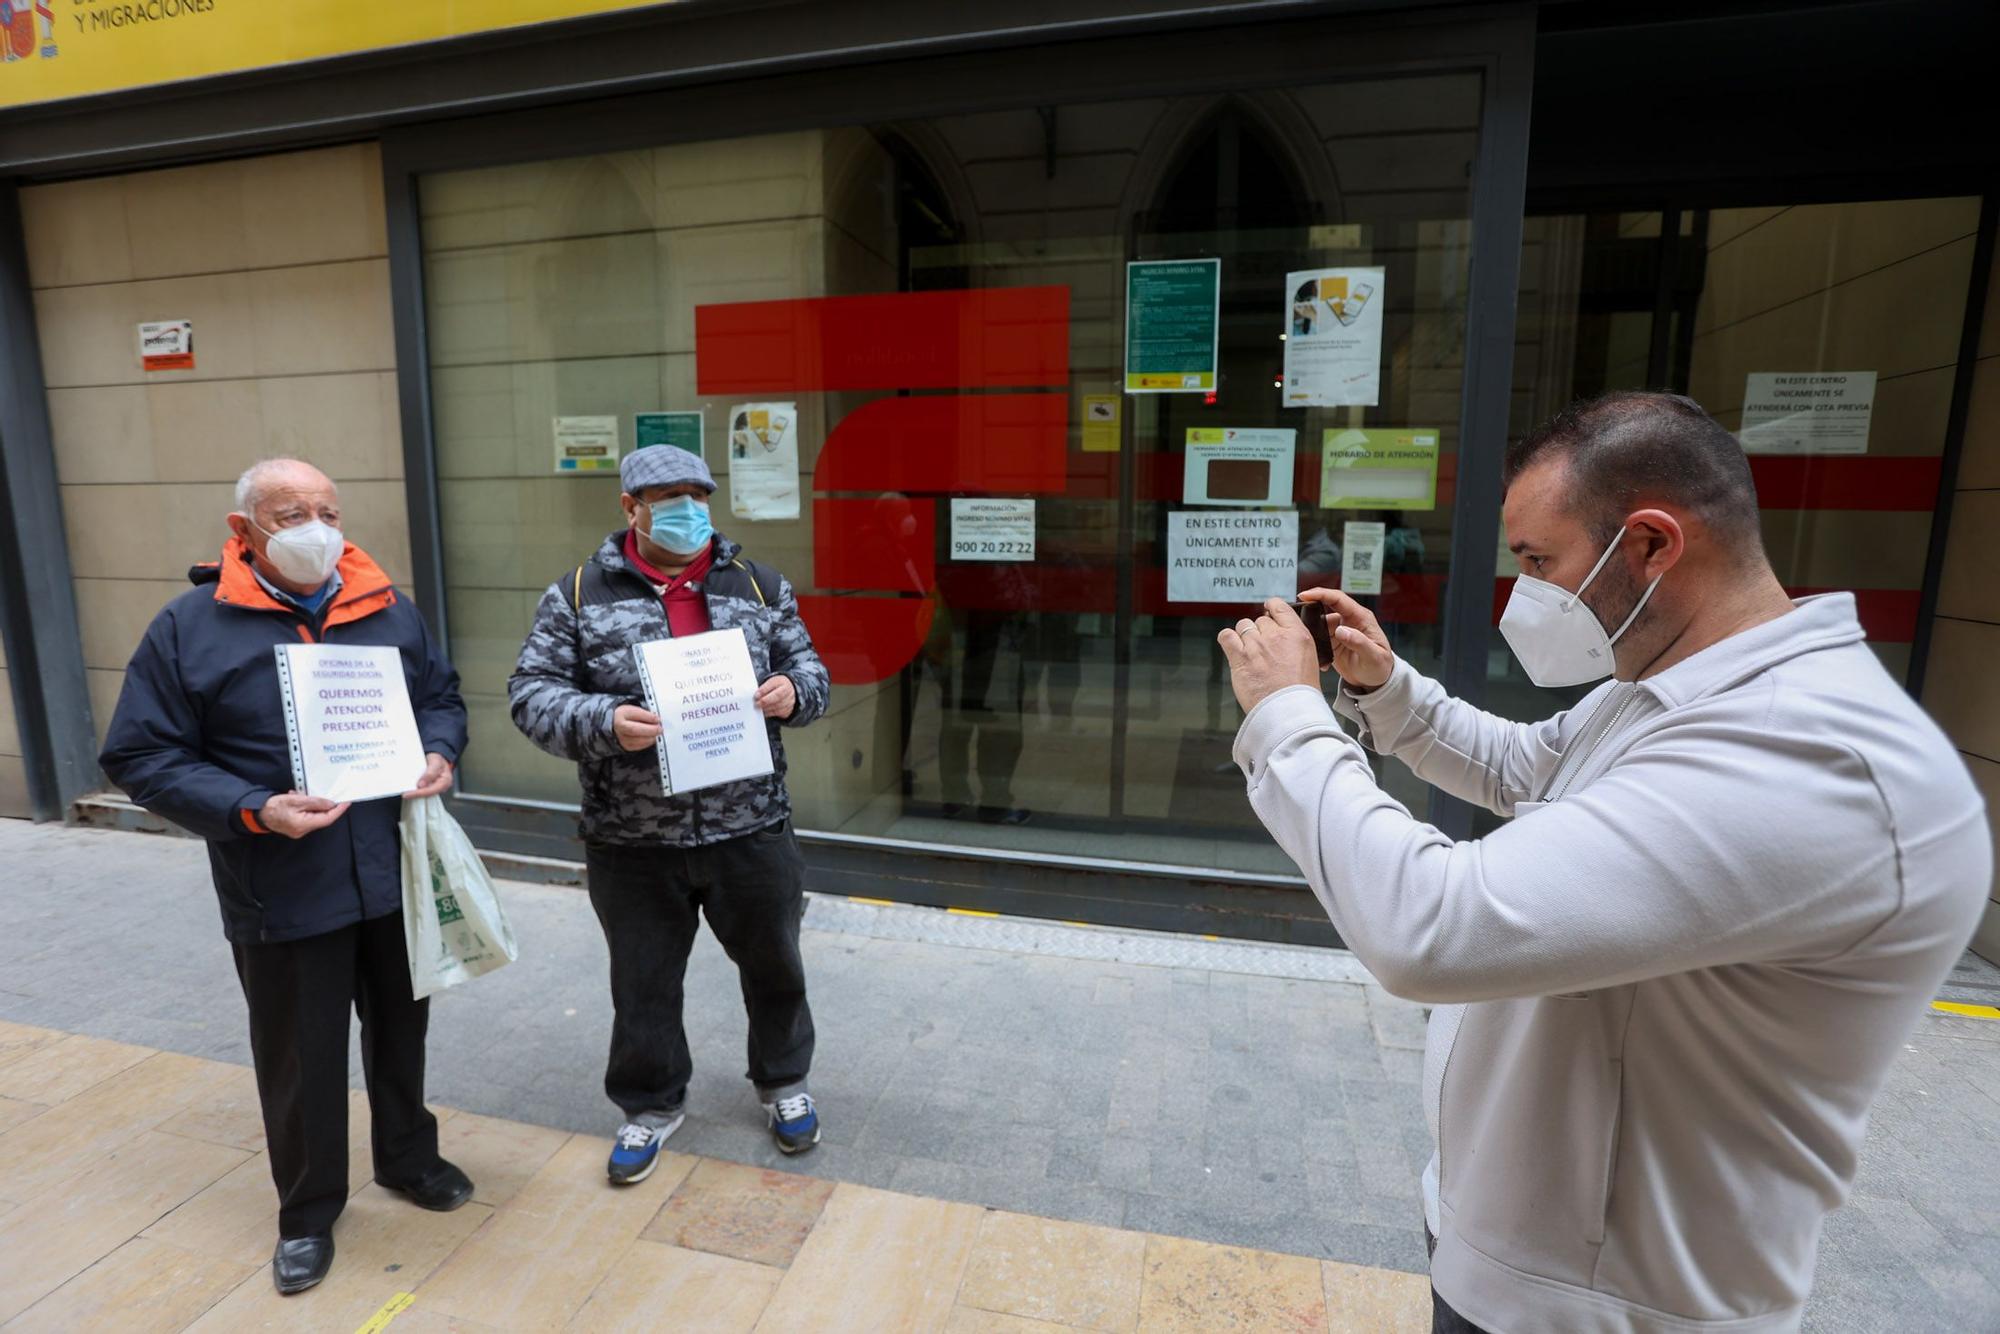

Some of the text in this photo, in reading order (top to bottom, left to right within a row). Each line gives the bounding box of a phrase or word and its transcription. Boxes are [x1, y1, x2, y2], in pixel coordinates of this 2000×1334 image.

[74, 0, 215, 33] Y MIGRACIONES
[1775, 376, 1847, 384] EN ESTE CENTRO
[1833, 389, 1844, 397] SE
[1792, 404, 1813, 412] CON
[1814, 404, 1835, 412] CITA
[1837, 403, 1870, 412] PREVIA
[1330, 450, 1372, 460] HORARIO
[1373, 450, 1385, 460] DE
[1186, 518, 1282, 529] EN ESTE CENTRO
[955, 541, 1032, 553] 900 20 22 22
[1186, 535, 1280, 548] ÚNICAMENTE SE
[1174, 556, 1295, 568] ATENDERÁ CON CITA
[1213, 577, 1255, 587] PREVIA
[312, 670, 383, 679] SEGURIDAD SOCIAL
[675, 672, 733, 690] QUEREMOS
[319, 689, 383, 700] QUEREMOS
[682, 687, 734, 705] ATENCION
[324, 705, 383, 716] ATENCION
[681, 702, 741, 721] PRESENCIAL
[322, 720, 390, 733] PRESENCIAL
[682, 722, 746, 742] NO HAY FORMA DE
[323, 743, 336, 752] NO
[337, 742, 354, 751] HAY
[355, 740, 385, 750] FORMA
[687, 733, 744, 752] CONSEGUIR CITA
[704, 746, 731, 759] PREVIA
